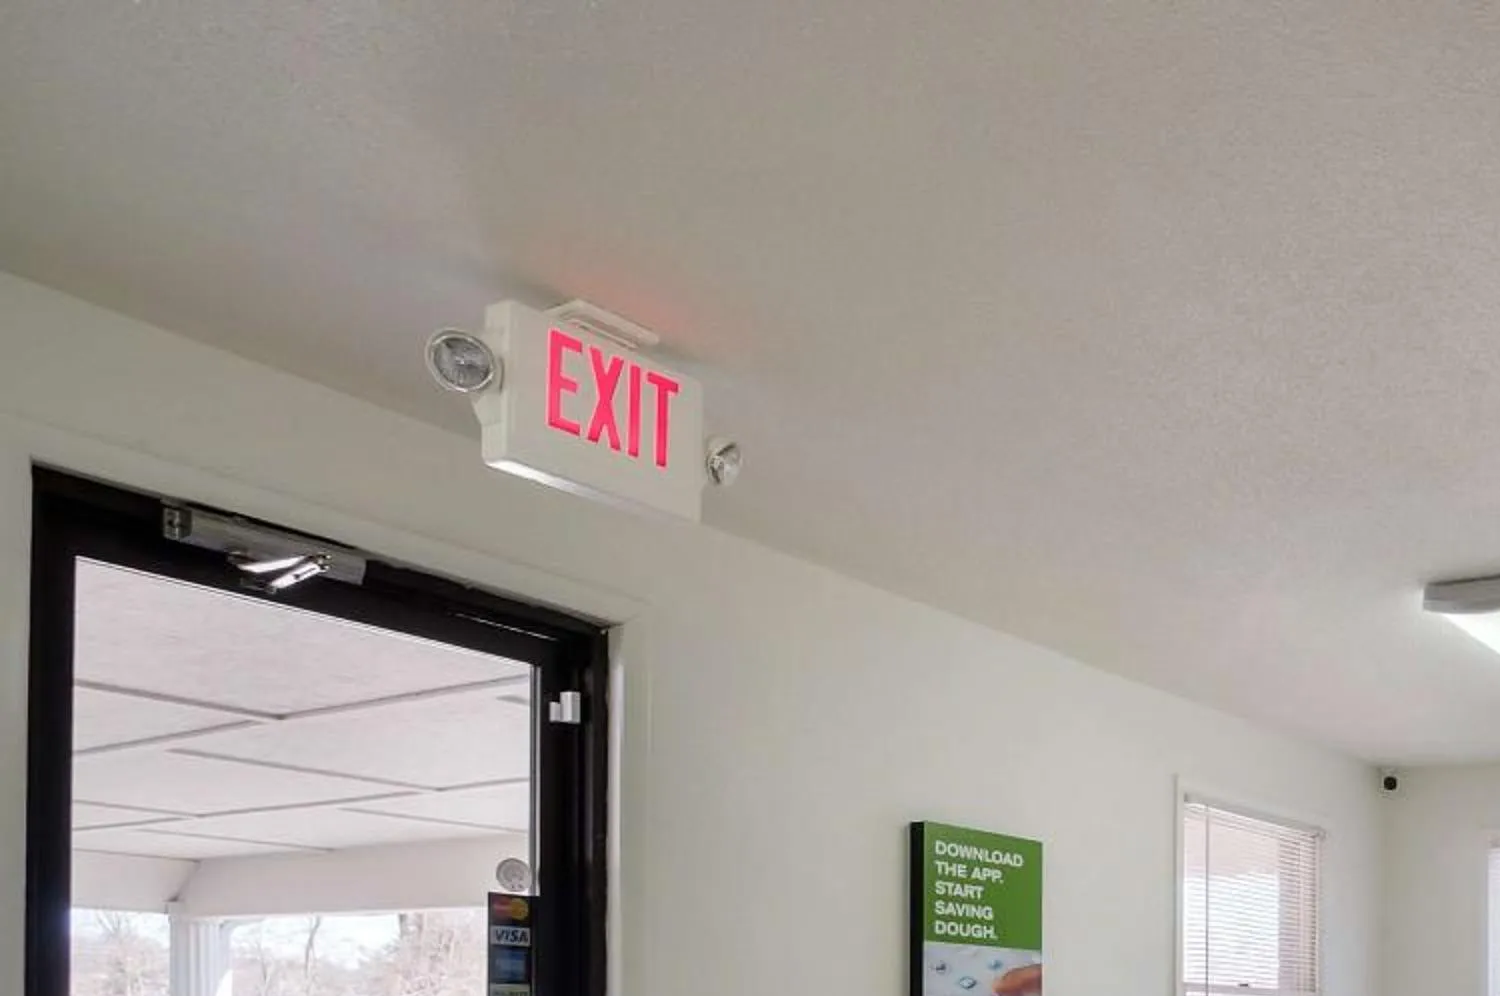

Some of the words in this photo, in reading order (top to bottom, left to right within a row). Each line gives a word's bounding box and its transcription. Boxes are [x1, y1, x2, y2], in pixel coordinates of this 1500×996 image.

[547, 329, 679, 468] EXIT
[935, 840, 1024, 868] DOWNLOAD
[935, 861, 968, 879] THE
[971, 867, 1004, 884] APP.
[935, 880, 984, 899] START
[935, 900, 994, 920] SAVING
[494, 929, 529, 943] VISA
[935, 920, 999, 940] DOUGH.
